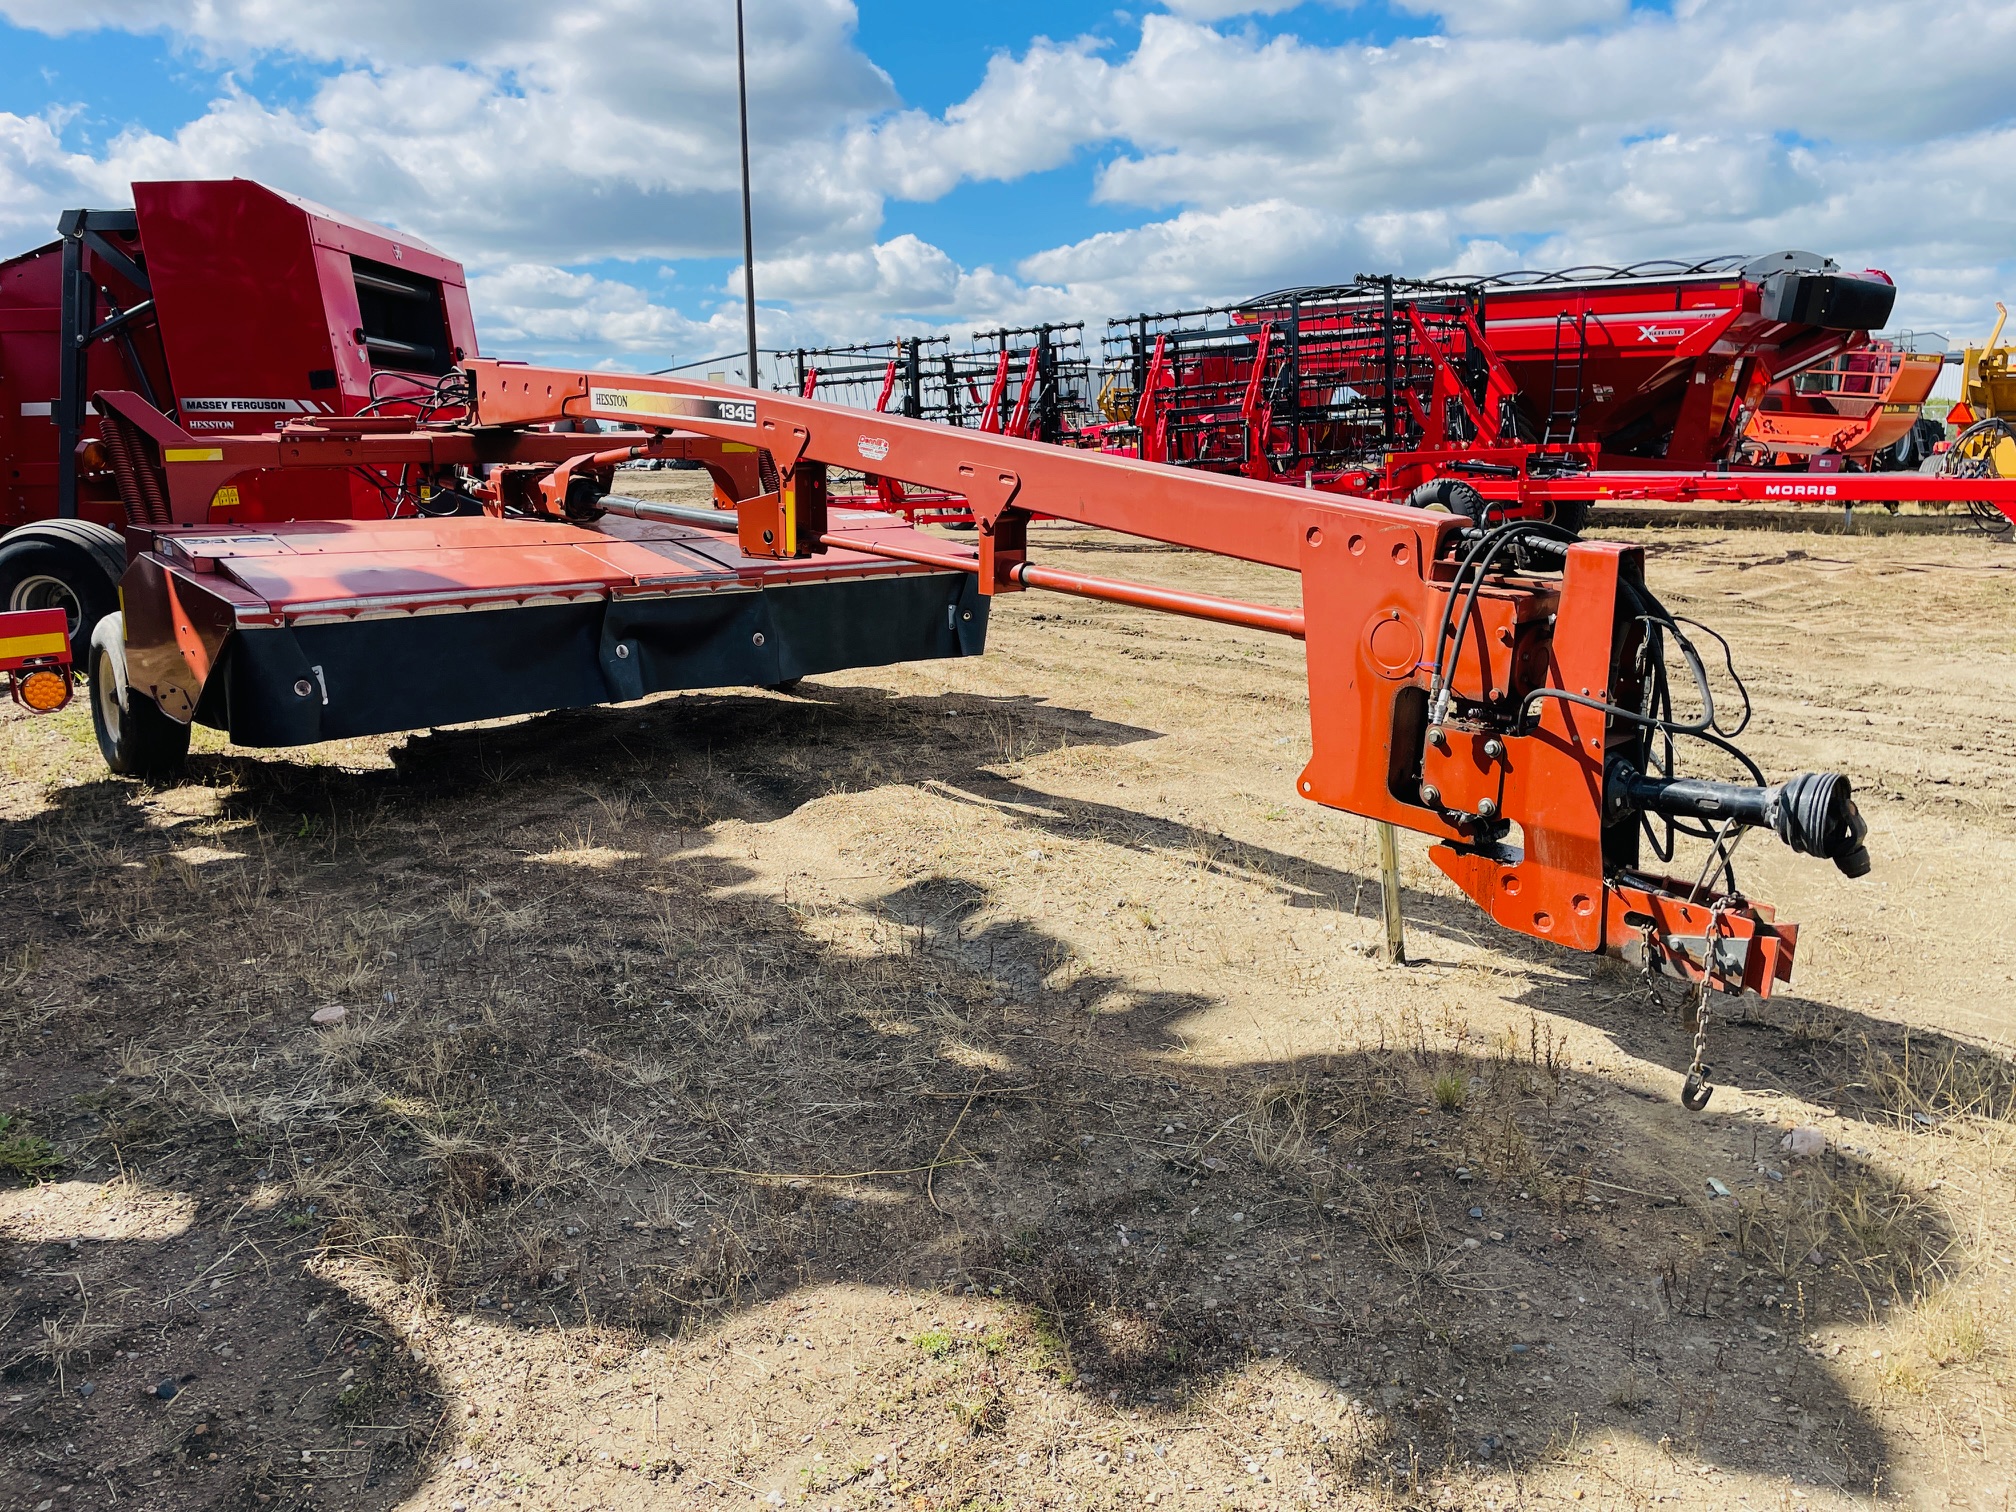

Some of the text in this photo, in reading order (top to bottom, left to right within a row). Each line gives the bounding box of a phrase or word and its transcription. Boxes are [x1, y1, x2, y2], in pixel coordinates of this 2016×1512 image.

[186, 401, 286, 410] MASSEY FERGUSON
[595, 393, 628, 408] HESSTON
[718, 403, 755, 421] 1345
[189, 420, 234, 429] HESSTON
[1765, 485, 1837, 496] MORRIS
